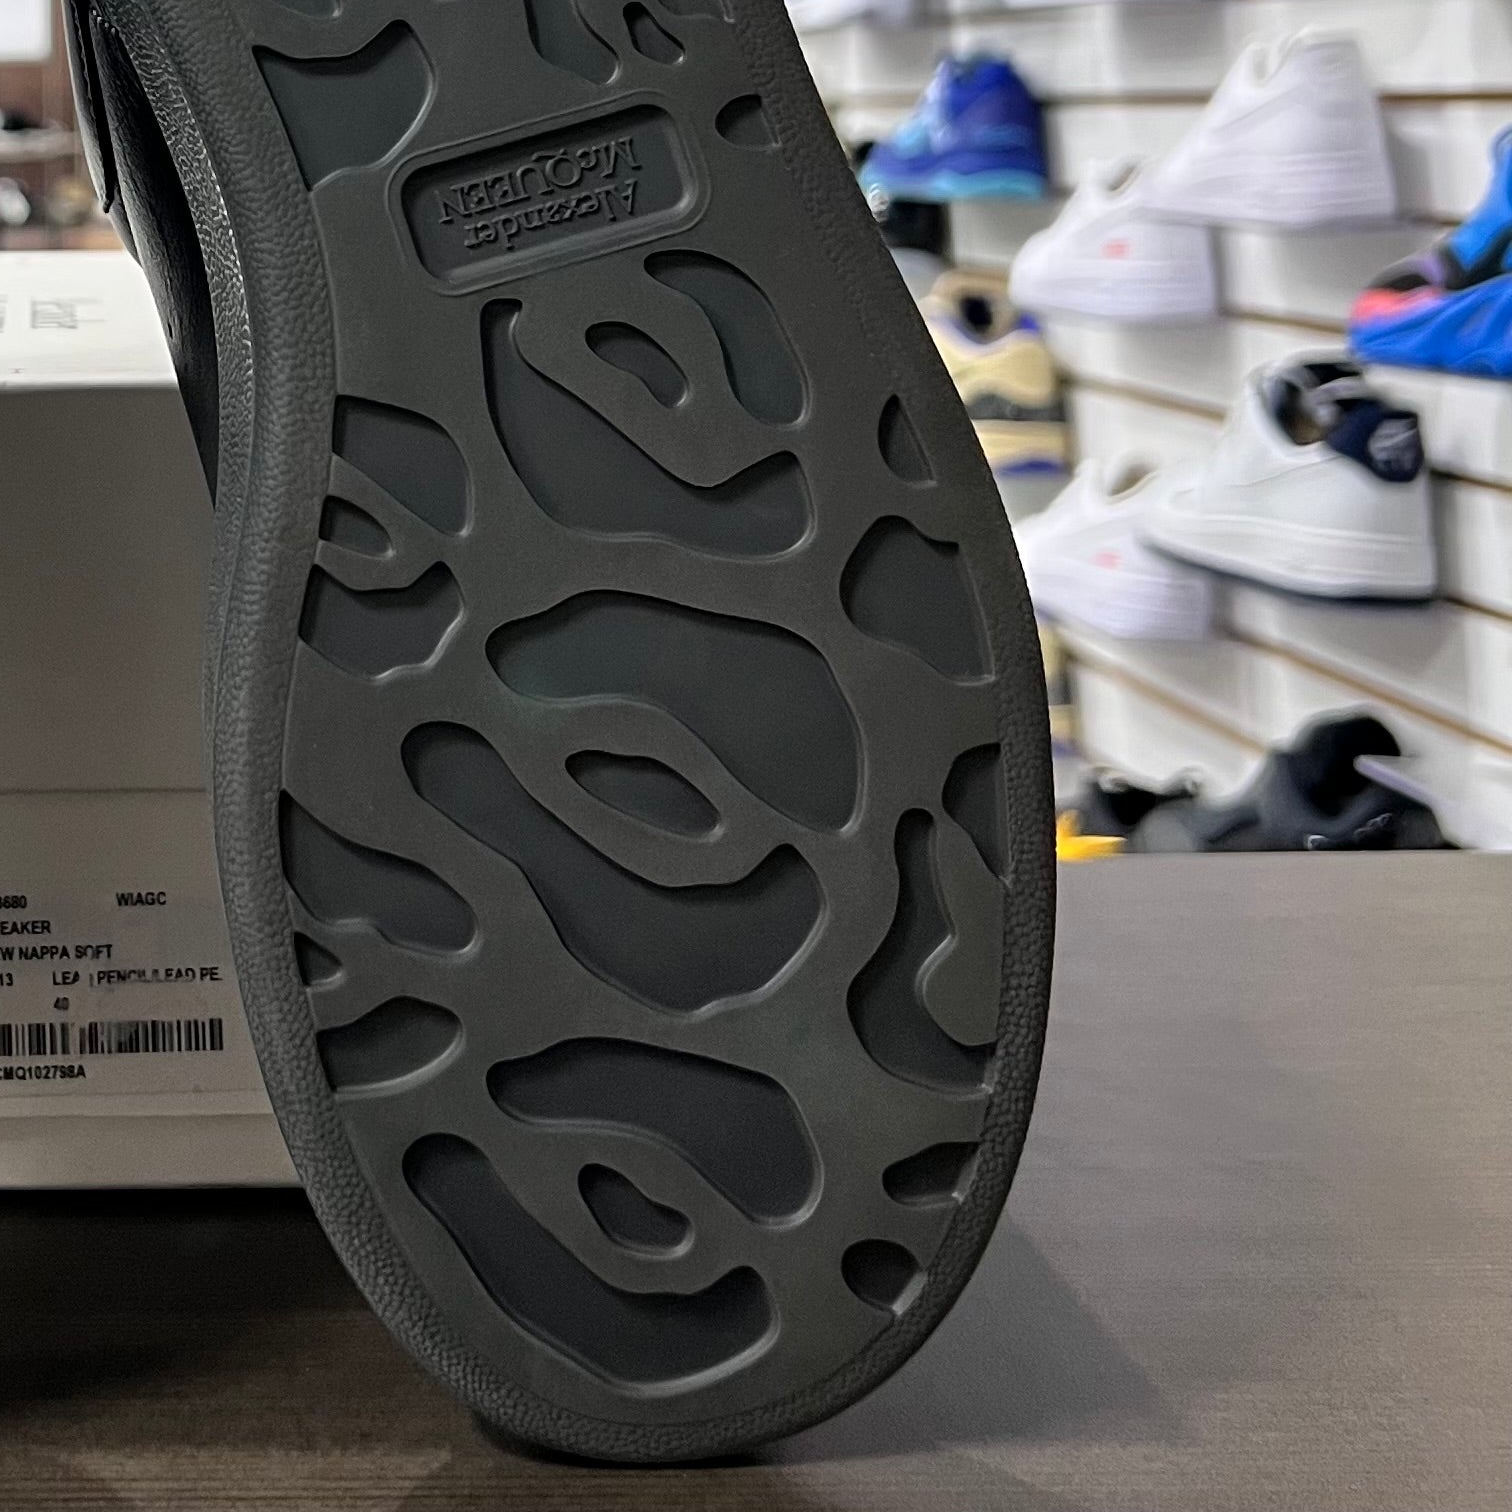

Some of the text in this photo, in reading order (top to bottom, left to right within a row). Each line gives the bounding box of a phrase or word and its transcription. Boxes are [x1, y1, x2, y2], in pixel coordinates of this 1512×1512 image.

[464, 179, 638, 250] Alexander
[116, 892, 167, 906] WIAGC
[19, 945, 70, 960] NAPPA
[75, 944, 113, 960] SOFT
